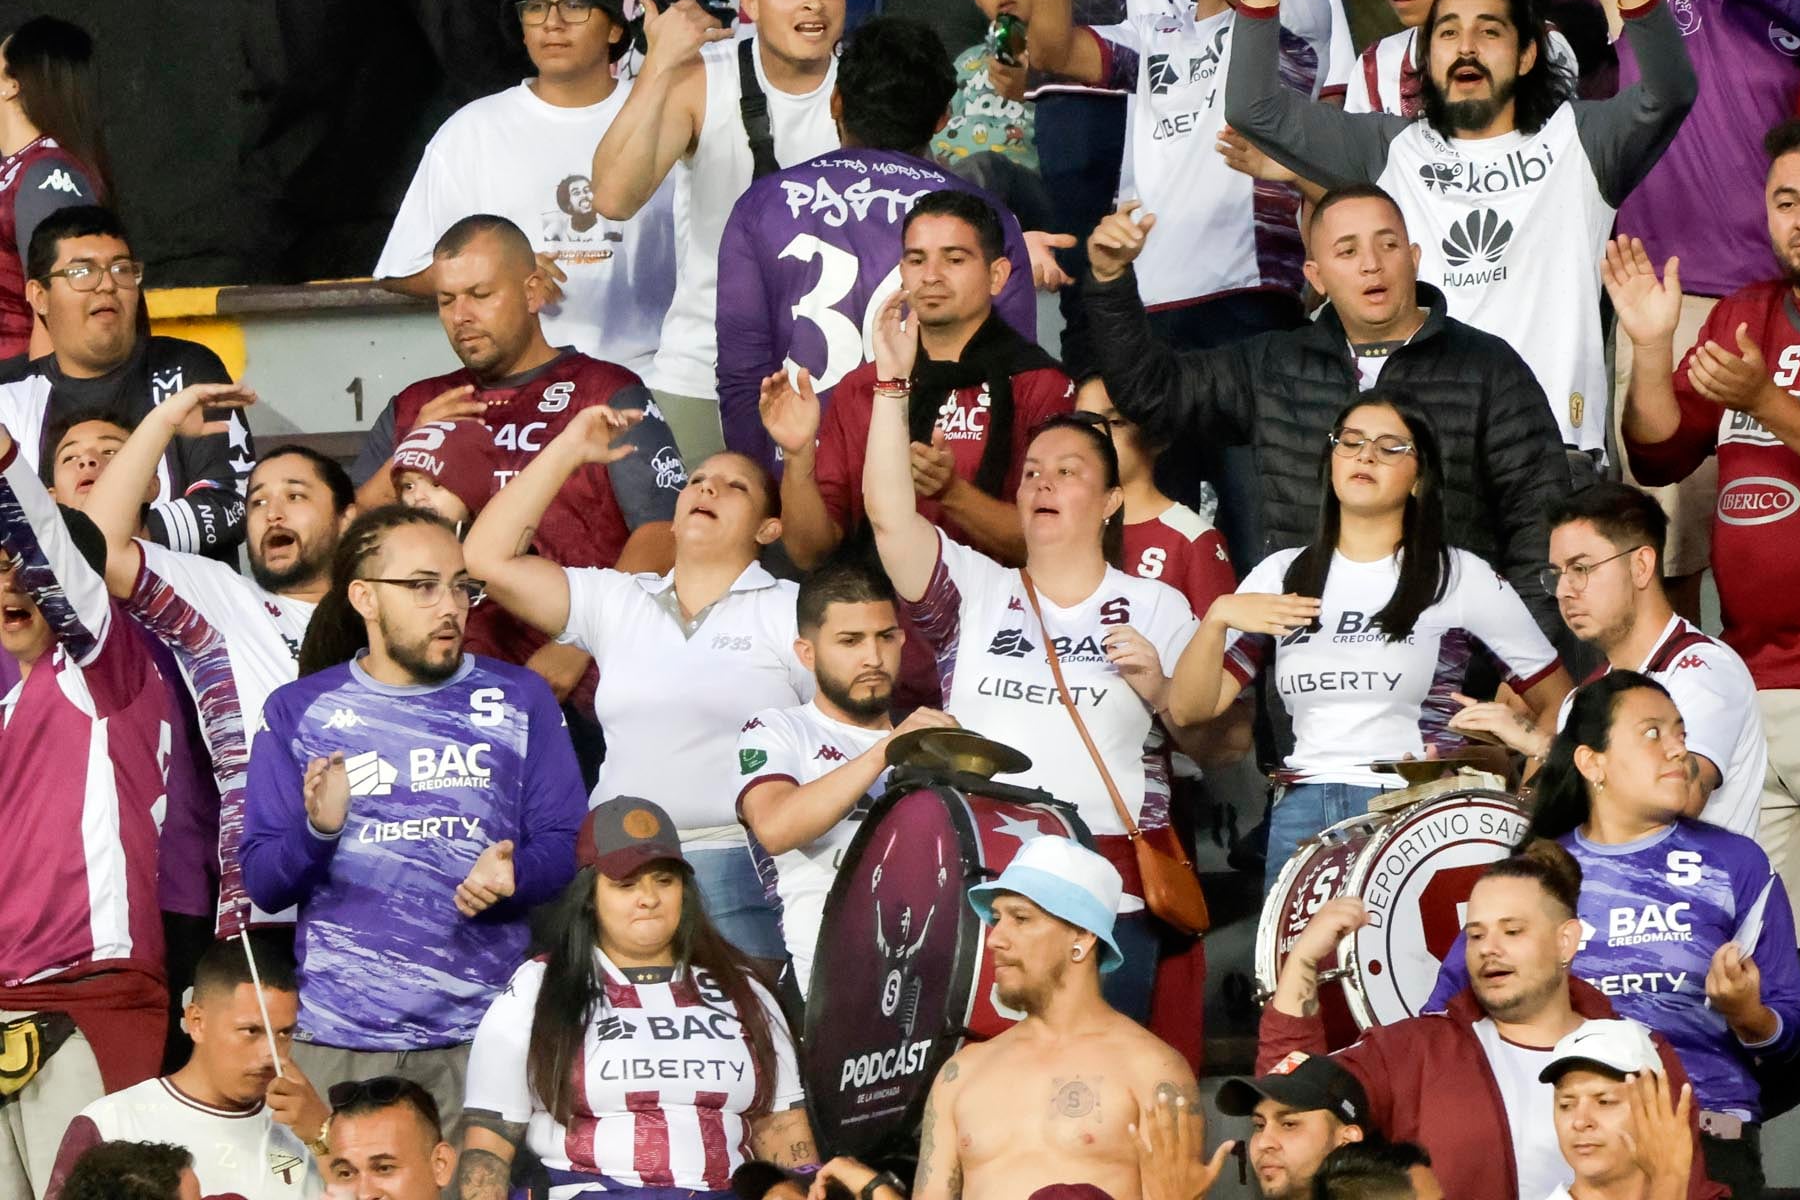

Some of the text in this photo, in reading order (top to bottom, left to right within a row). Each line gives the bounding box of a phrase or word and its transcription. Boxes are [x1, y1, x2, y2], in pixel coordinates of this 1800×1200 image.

[1465, 142, 1555, 194] kölbi
[1443, 266, 1508, 287] HUAWEI
[345, 376, 363, 423] 1
[537, 381, 576, 413] S
[1721, 492, 1791, 511] IBERICO
[1137, 546, 1167, 579] S
[1100, 596, 1130, 625] S
[977, 676, 1109, 707] LIBERTY
[1280, 671, 1403, 695] LIBERTY
[469, 687, 505, 727] S
[409, 742, 492, 782] BAC
[410, 776, 491, 793] CREDOMATIC
[358, 816, 480, 844] LIBERTY
[1665, 850, 1703, 886] S
[1608, 901, 1692, 939] BAC
[1606, 931, 1694, 948] CREDOMATIC
[646, 1014, 737, 1040] BAC
[599, 1058, 745, 1083] LIBERTY
[839, 1039, 932, 1093] PODCAST
